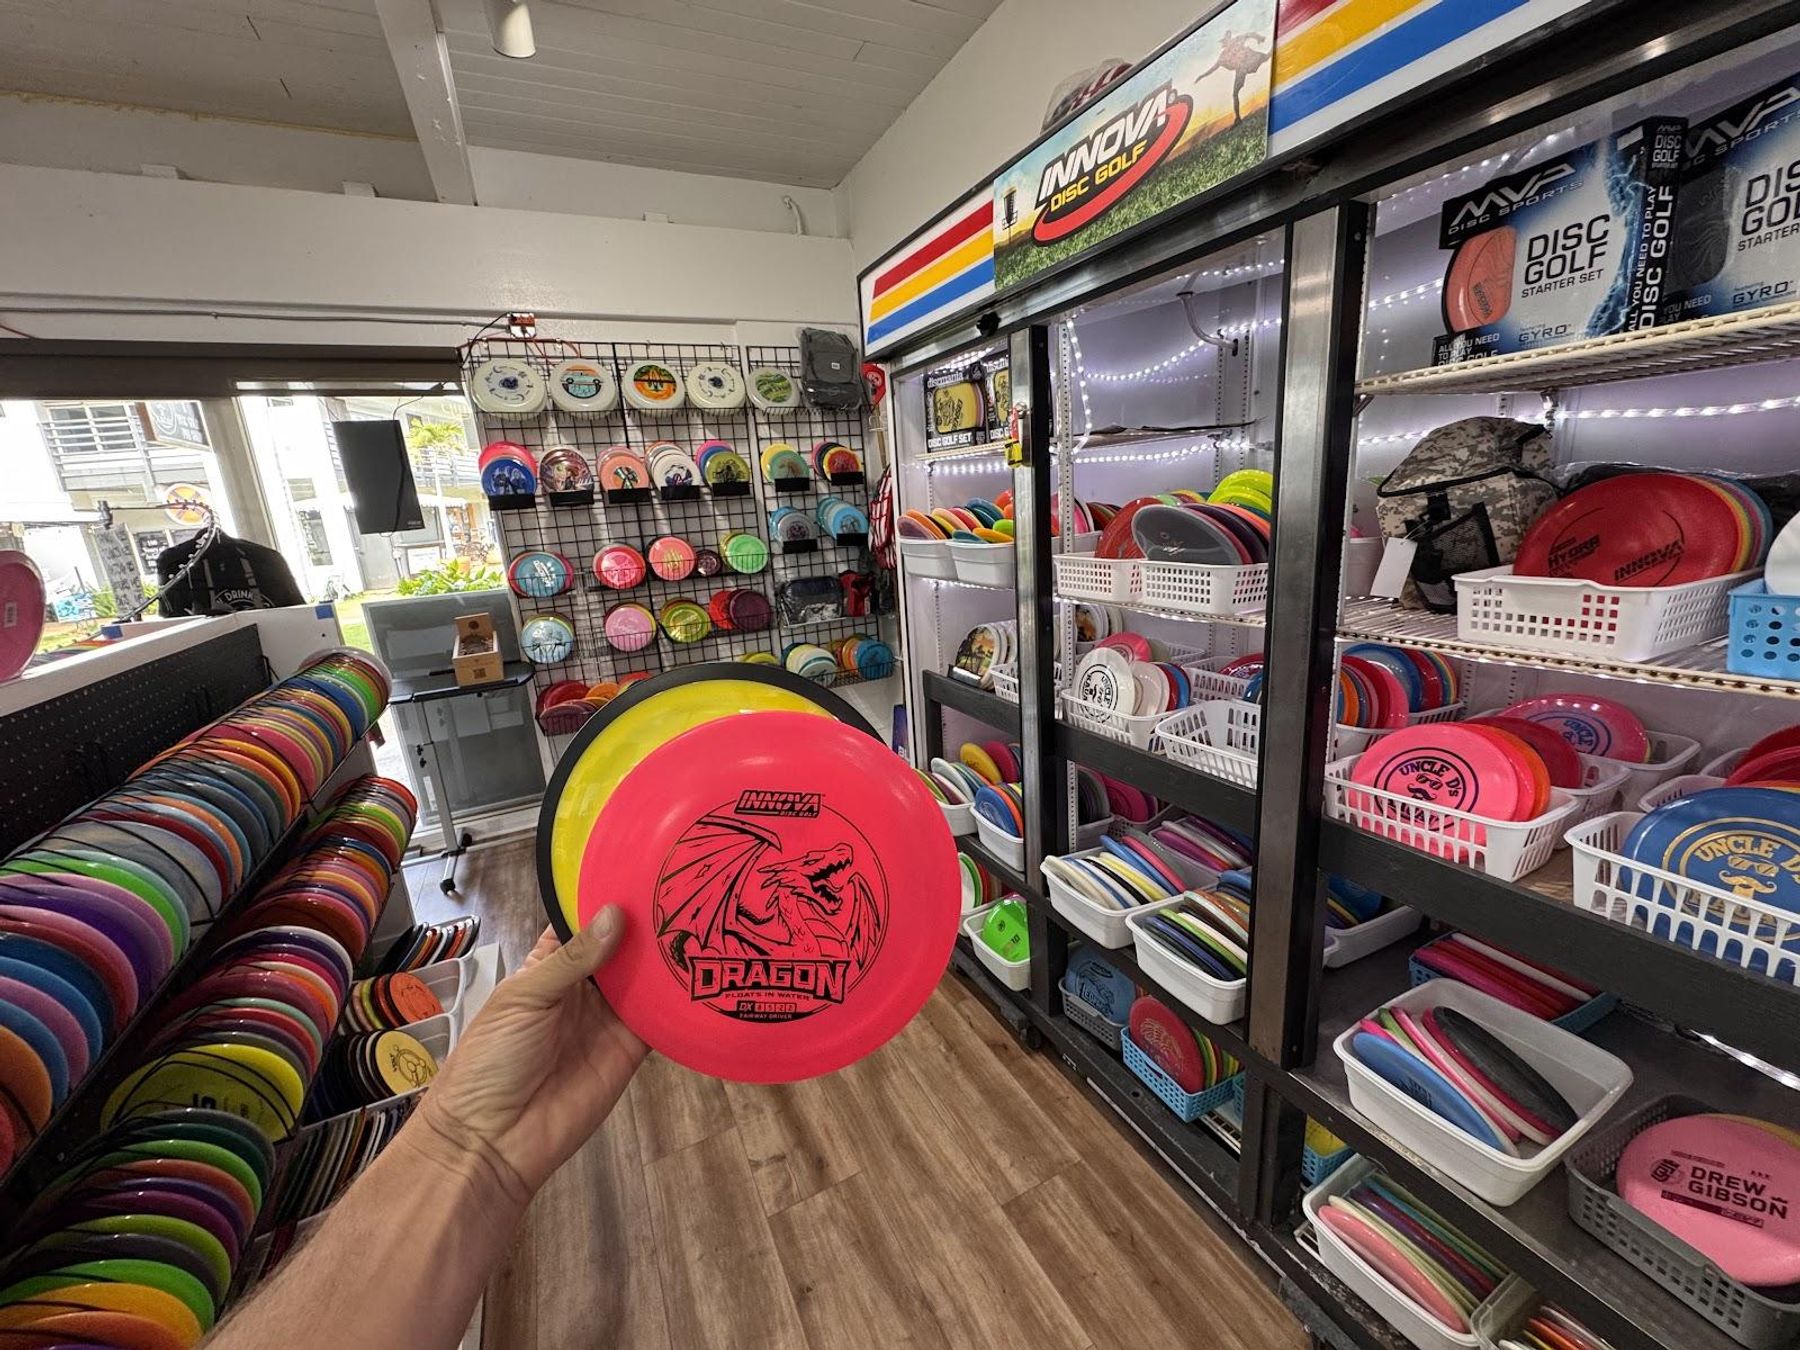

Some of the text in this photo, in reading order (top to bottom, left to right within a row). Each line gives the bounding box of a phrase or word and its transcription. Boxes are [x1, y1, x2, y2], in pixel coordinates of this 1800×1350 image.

[1039, 89, 1168, 201] INNOVA
[1652, 149, 1680, 162] GOLF
[1655, 134, 1682, 149] DISC
[1050, 139, 1148, 212] DISC GOLF
[1745, 159, 1800, 208] DIS
[1448, 181, 1584, 235] DISC SPORTS
[1450, 163, 1577, 226] MVP
[1526, 213, 1611, 263] DISC
[1524, 240, 1608, 285] GOLF
[1628, 186, 1657, 332] ALL YOU NEED TO PLAY
[1638, 267, 1662, 331] DISC
[1650, 185, 1674, 259] GOLF
[1521, 268, 1605, 299] STARTER SET
[1732, 280, 1790, 305] GYRO
[1684, 293, 1712, 310] NEED
[1474, 333, 1500, 346] NEED
[1518, 323, 1568, 342] GYRO
[928, 432, 972, 449] DISC GOLF SET
[1614, 539, 1684, 582] INNOVA
[224, 589, 254, 601] DRINK
[1399, 760, 1451, 777] UNCLE
[738, 790, 820, 812] INNOVA
[1694, 835, 1782, 862] UNCLE
[692, 958, 850, 1003] DRAGON
[739, 1002, 754, 1011] DX
[1691, 1166, 1766, 1196] DREW
